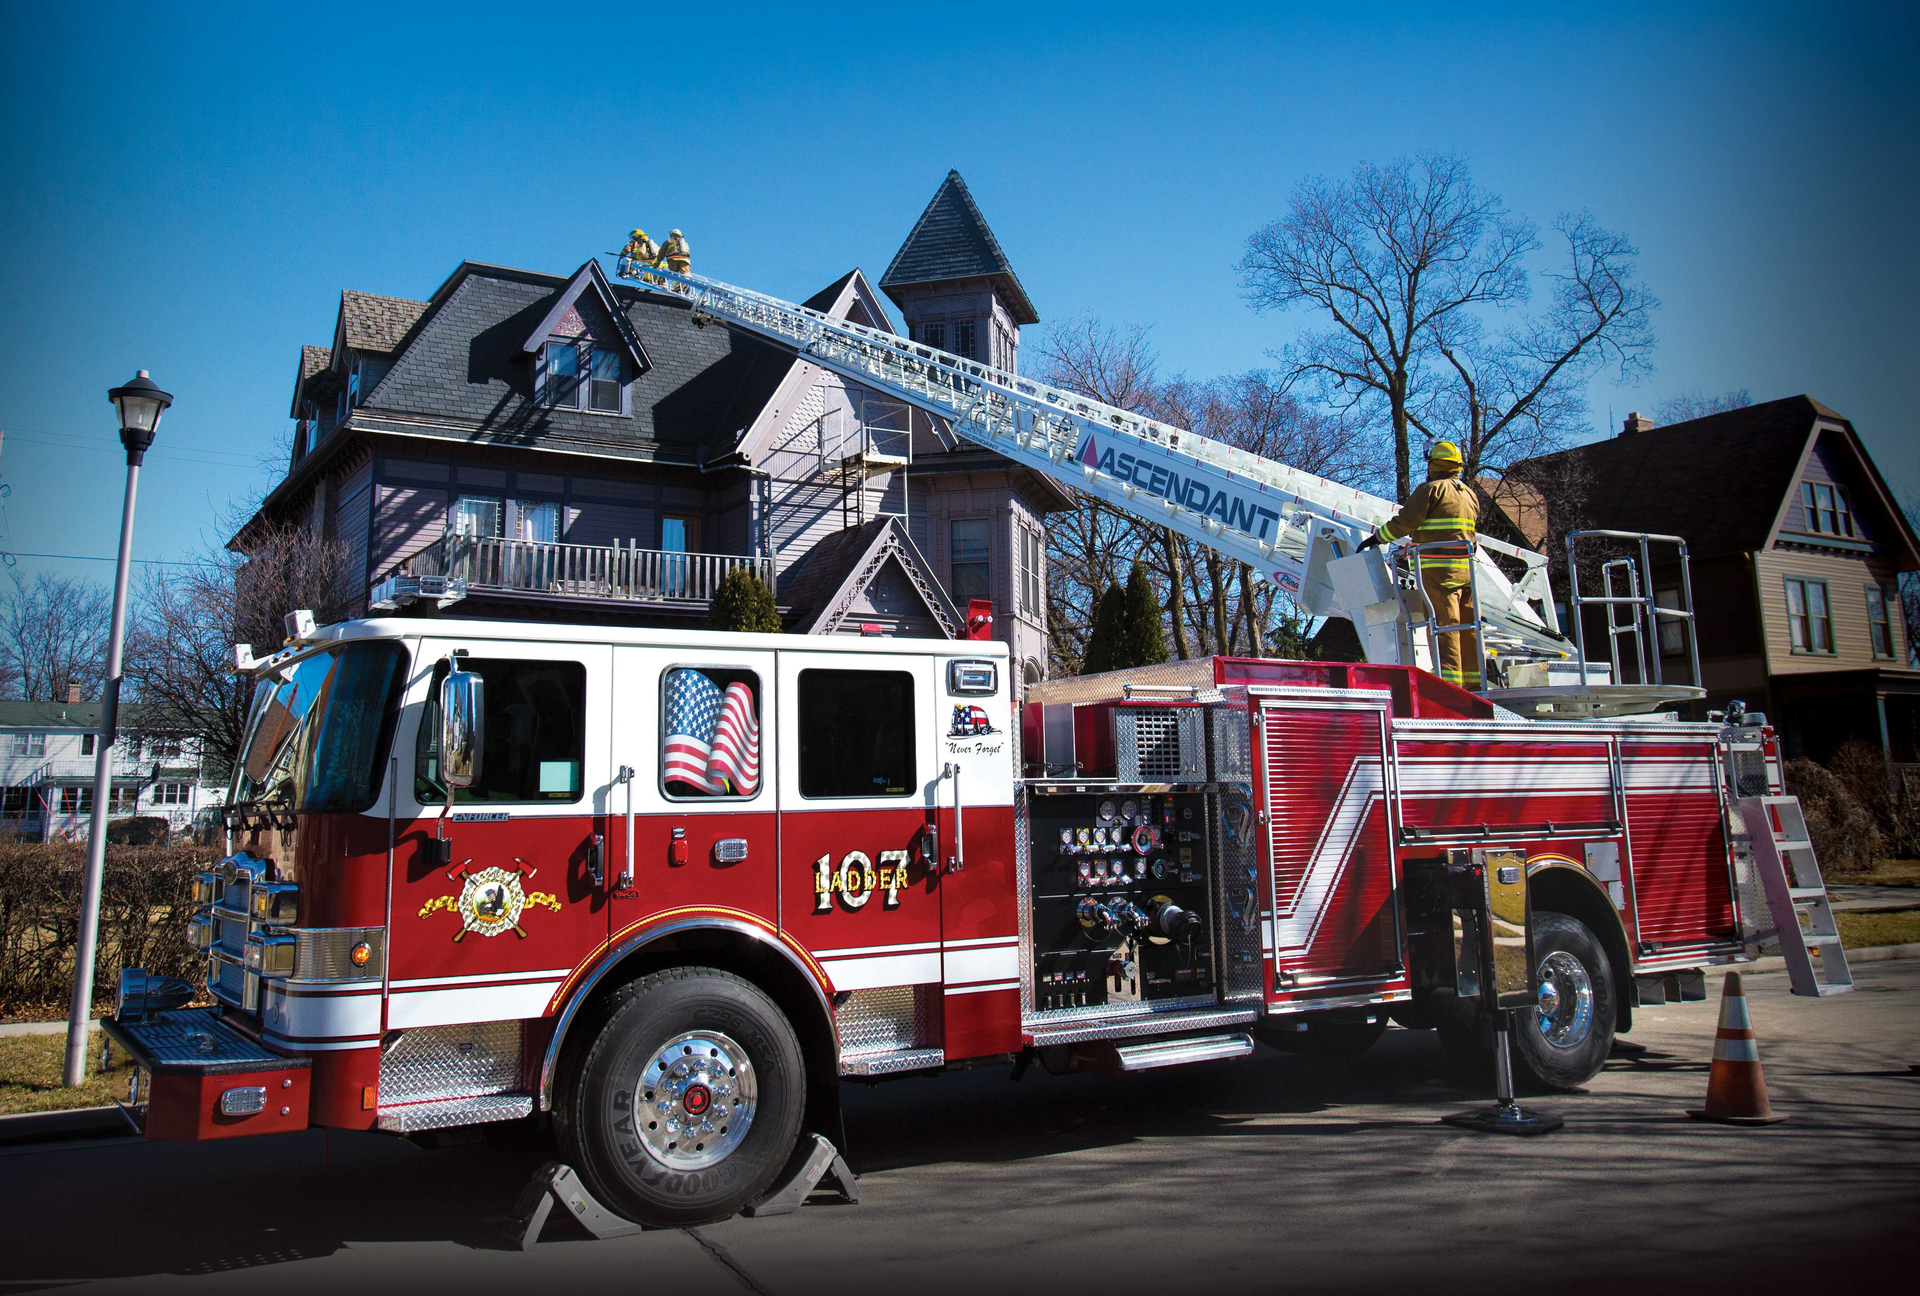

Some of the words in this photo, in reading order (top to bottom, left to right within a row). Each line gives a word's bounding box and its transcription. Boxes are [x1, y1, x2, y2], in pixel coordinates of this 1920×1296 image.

[1095, 446, 1280, 540] ASCENDANT
[1280, 575, 1299, 589] Pierc
[452, 813, 509, 822] ENFORCER
[813, 849, 910, 912] 107
[815, 868, 908, 893] LADDER
[613, 1089, 739, 1196] GOODYEAR
